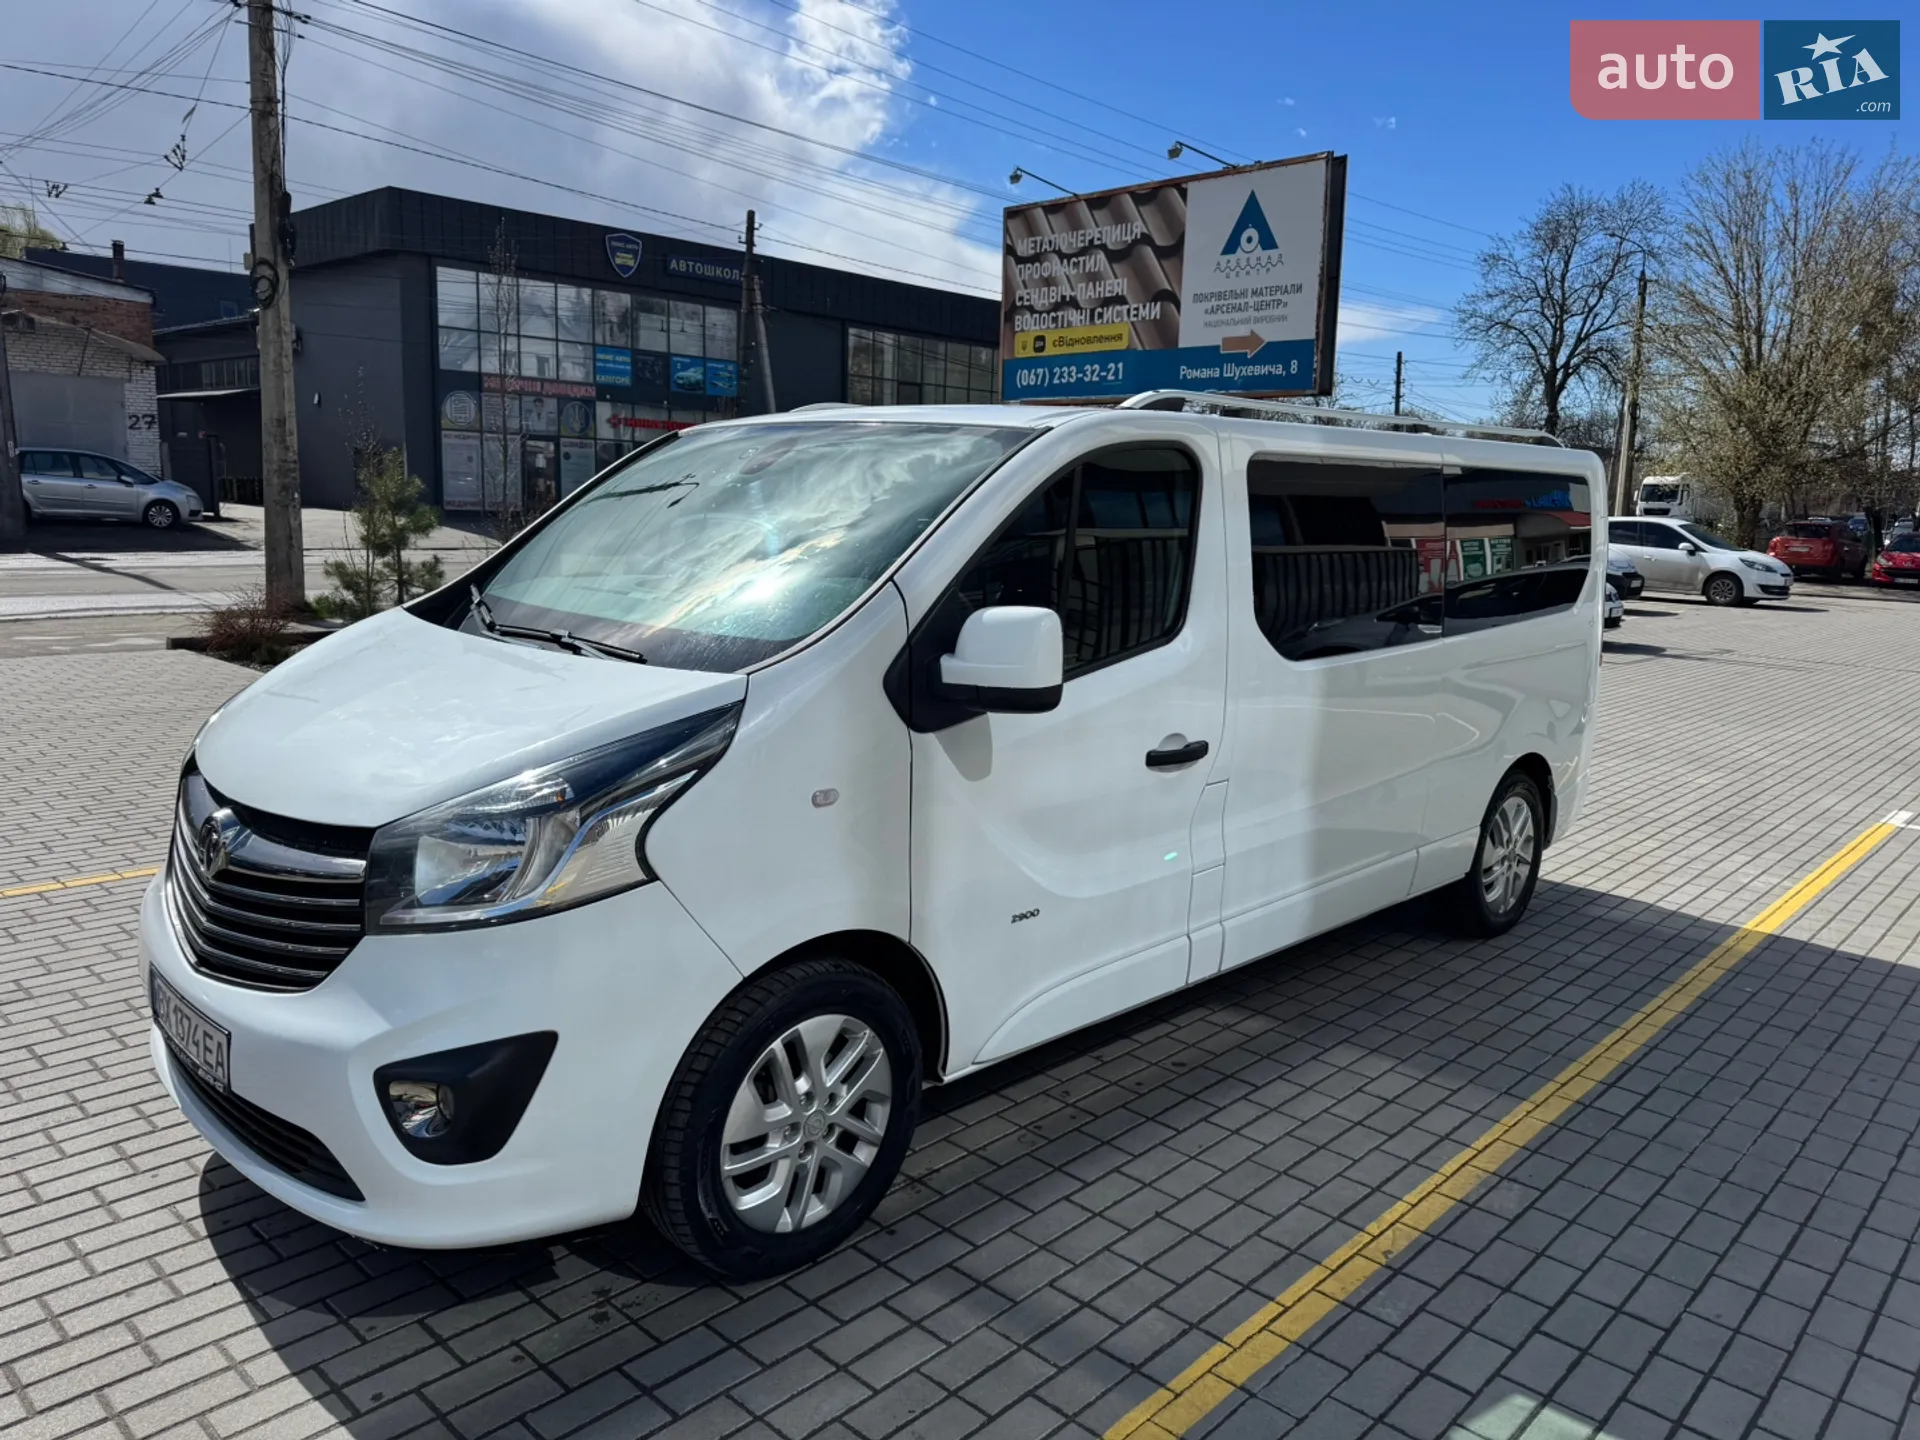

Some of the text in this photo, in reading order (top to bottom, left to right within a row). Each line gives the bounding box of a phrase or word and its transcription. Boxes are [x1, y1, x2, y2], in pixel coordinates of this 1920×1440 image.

[1017, 222, 1142, 255] МЕТАЛОЧЕРЕПИЦЯ
[1016, 253, 1105, 281] ПРОФНАСТИЛ
[1015, 277, 1128, 307] СЕНДВІЧ-ПАНЕЛІ
[1192, 282, 1303, 304] ПОКРІВЕЛЬНІ МАТЕРІАЛИ
[1014, 301, 1162, 332] ВОДОСТІЧНІ СИСТЕМИ
[1204, 298, 1288, 316] «АРСЕНАЛ-ЦЕНТР»
[1052, 333, 1123, 348] єВідновлення
[1016, 361, 1124, 388] (067) 233-32-21
[1179, 359, 1298, 381] Романа Шухевича, 8
[128, 414, 157, 431] 27
